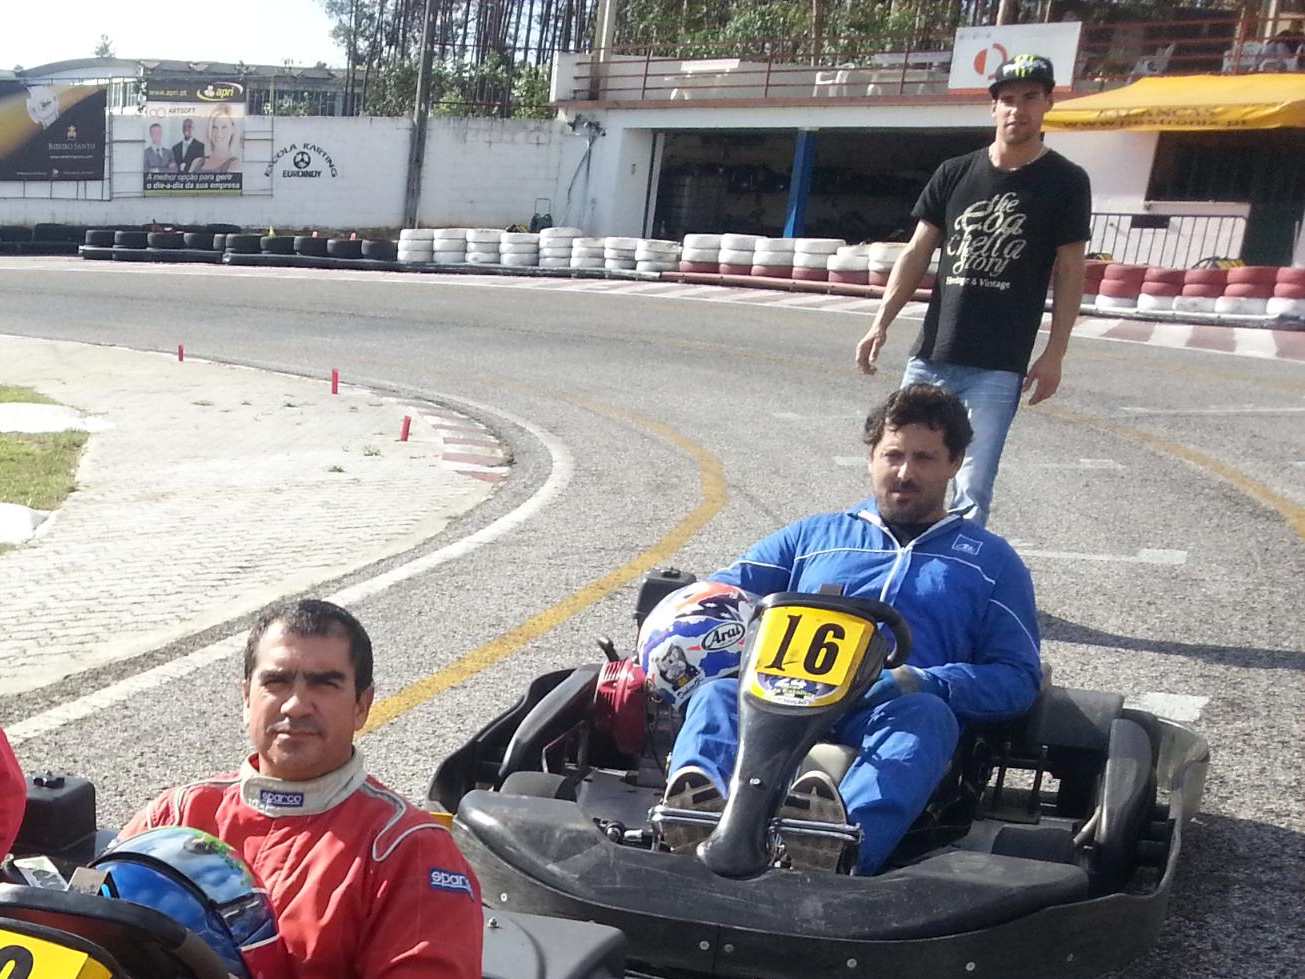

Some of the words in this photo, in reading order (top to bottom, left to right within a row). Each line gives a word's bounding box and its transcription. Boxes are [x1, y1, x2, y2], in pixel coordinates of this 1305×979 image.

[216, 86, 235, 98] apri
[264, 144, 297, 177] ESCOLA
[303, 143, 338, 178] KARTING
[199, 174, 215, 182] para
[282, 170, 322, 178] EUROINDY
[209, 182, 240, 190] empresa
[979, 278, 1011, 291] Vintage
[706, 624, 741, 649] Arai
[764, 613, 846, 676] 16
[262, 791, 302, 804] sparco
